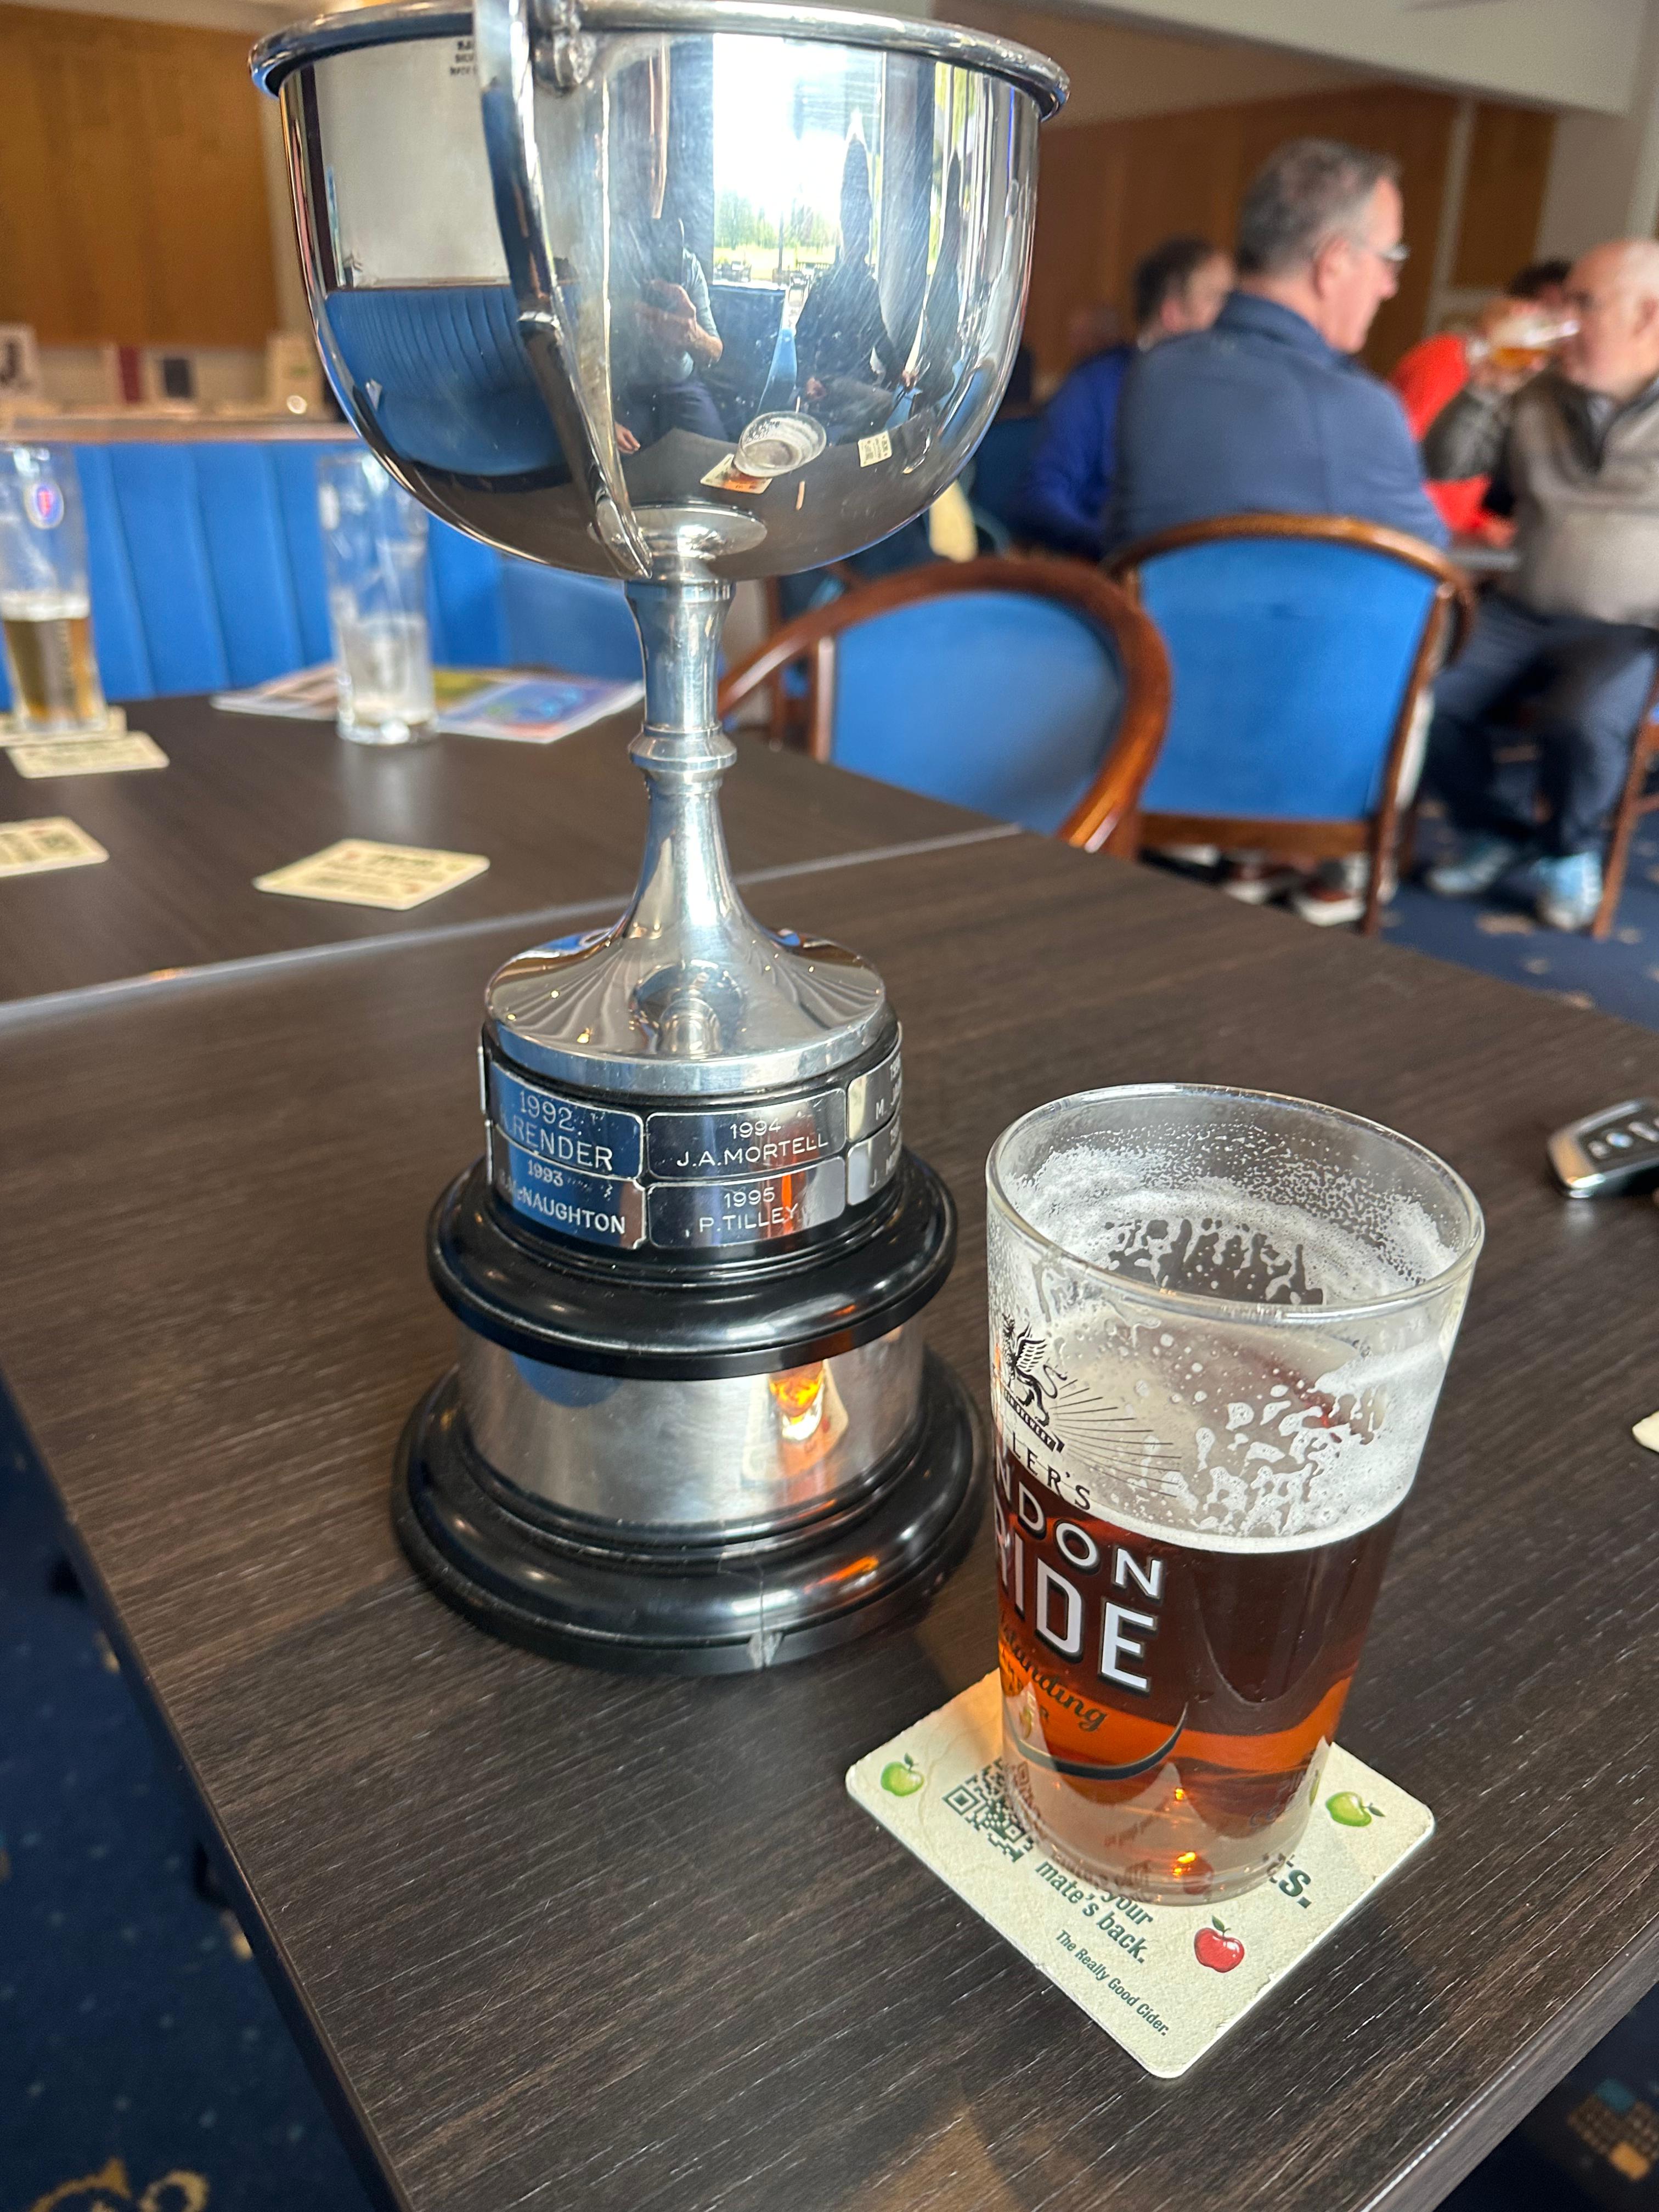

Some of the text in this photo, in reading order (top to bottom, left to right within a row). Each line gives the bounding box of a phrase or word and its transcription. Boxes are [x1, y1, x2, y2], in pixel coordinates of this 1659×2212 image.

[512, 1114, 613, 1172] RENDER
[730, 1118, 782, 1139] 1994
[527, 1159, 564, 1187] 1993
[724, 1187, 776, 1209] 1995
[698, 1203, 799, 1233] P.TILLEY
[1012, 1431, 1091, 1510] LER'S
[995, 1443, 1163, 1601] NDON
[994, 1481, 1156, 1692] RIDE
[1034, 1860, 1099, 1917] mate's
[1096, 1910, 1148, 1964] back.
[1055, 1929, 1169, 2037] The Really Good Cider.
